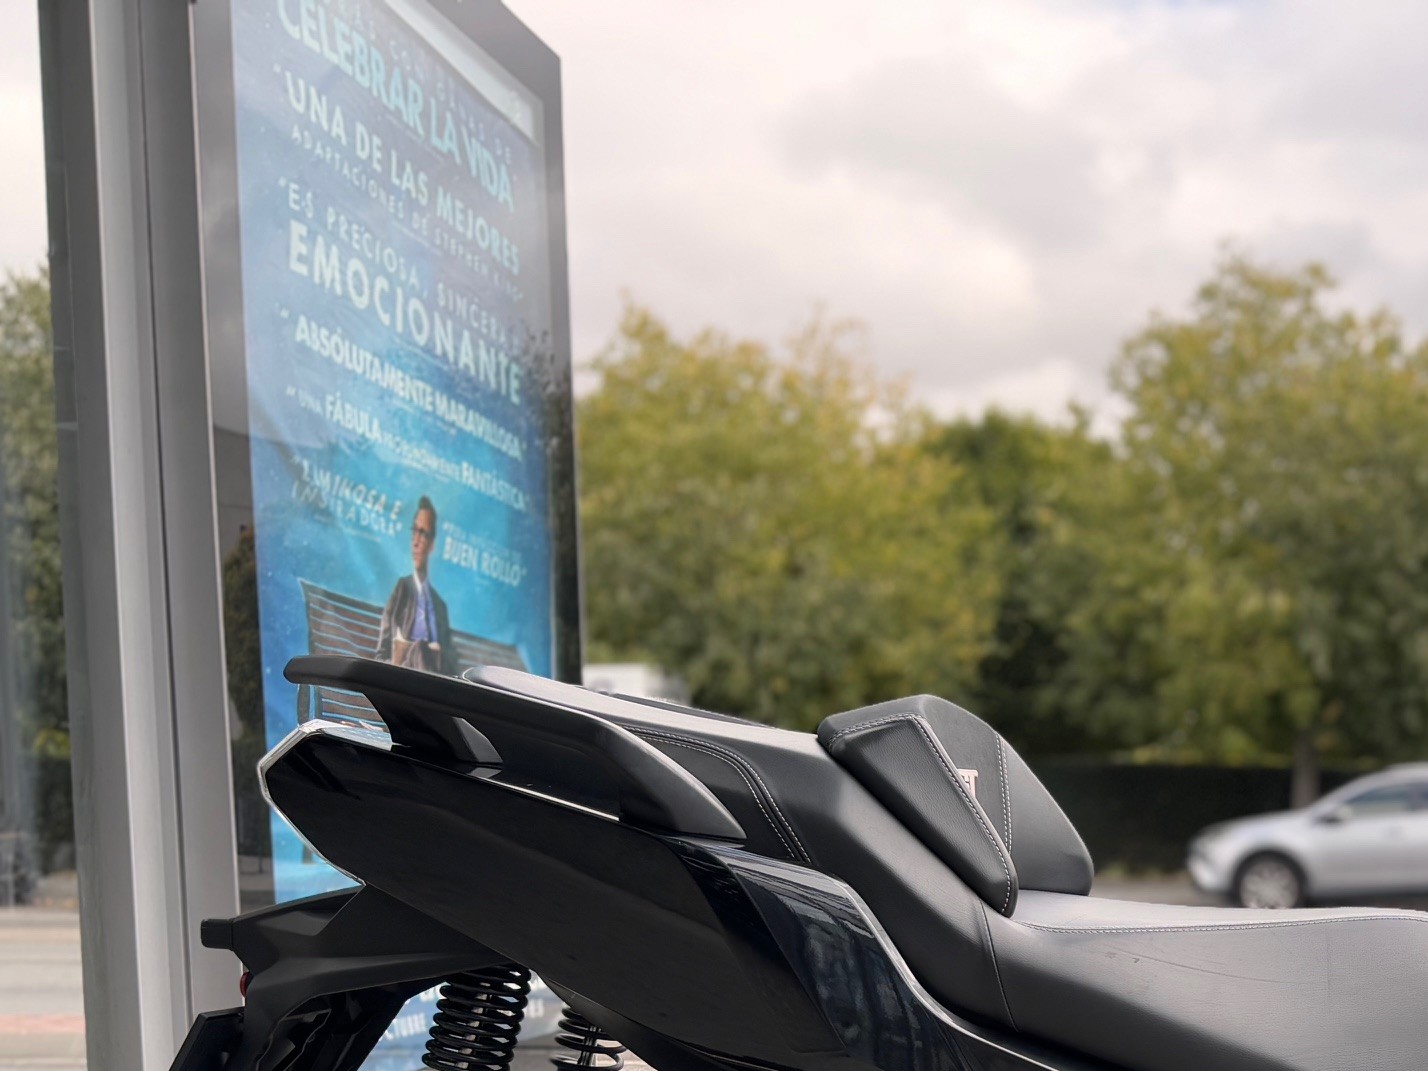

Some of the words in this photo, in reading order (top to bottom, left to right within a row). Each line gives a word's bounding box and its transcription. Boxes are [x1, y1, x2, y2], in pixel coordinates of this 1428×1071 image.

[276, 0, 424, 136] CELEBRAR
[429, 97, 461, 165] LA
[461, 123, 516, 214] VIDA
[292, 123, 405, 220] ADAPTACIONES
[355, 121, 383, 174] DE
[391, 149, 428, 206] LAS
[437, 185, 520, 276] MEJORES
[289, 218, 521, 407] EMOCIONANTE
[325, 391, 382, 443] FÁBULA
[442, 535, 480, 572] BUEN
